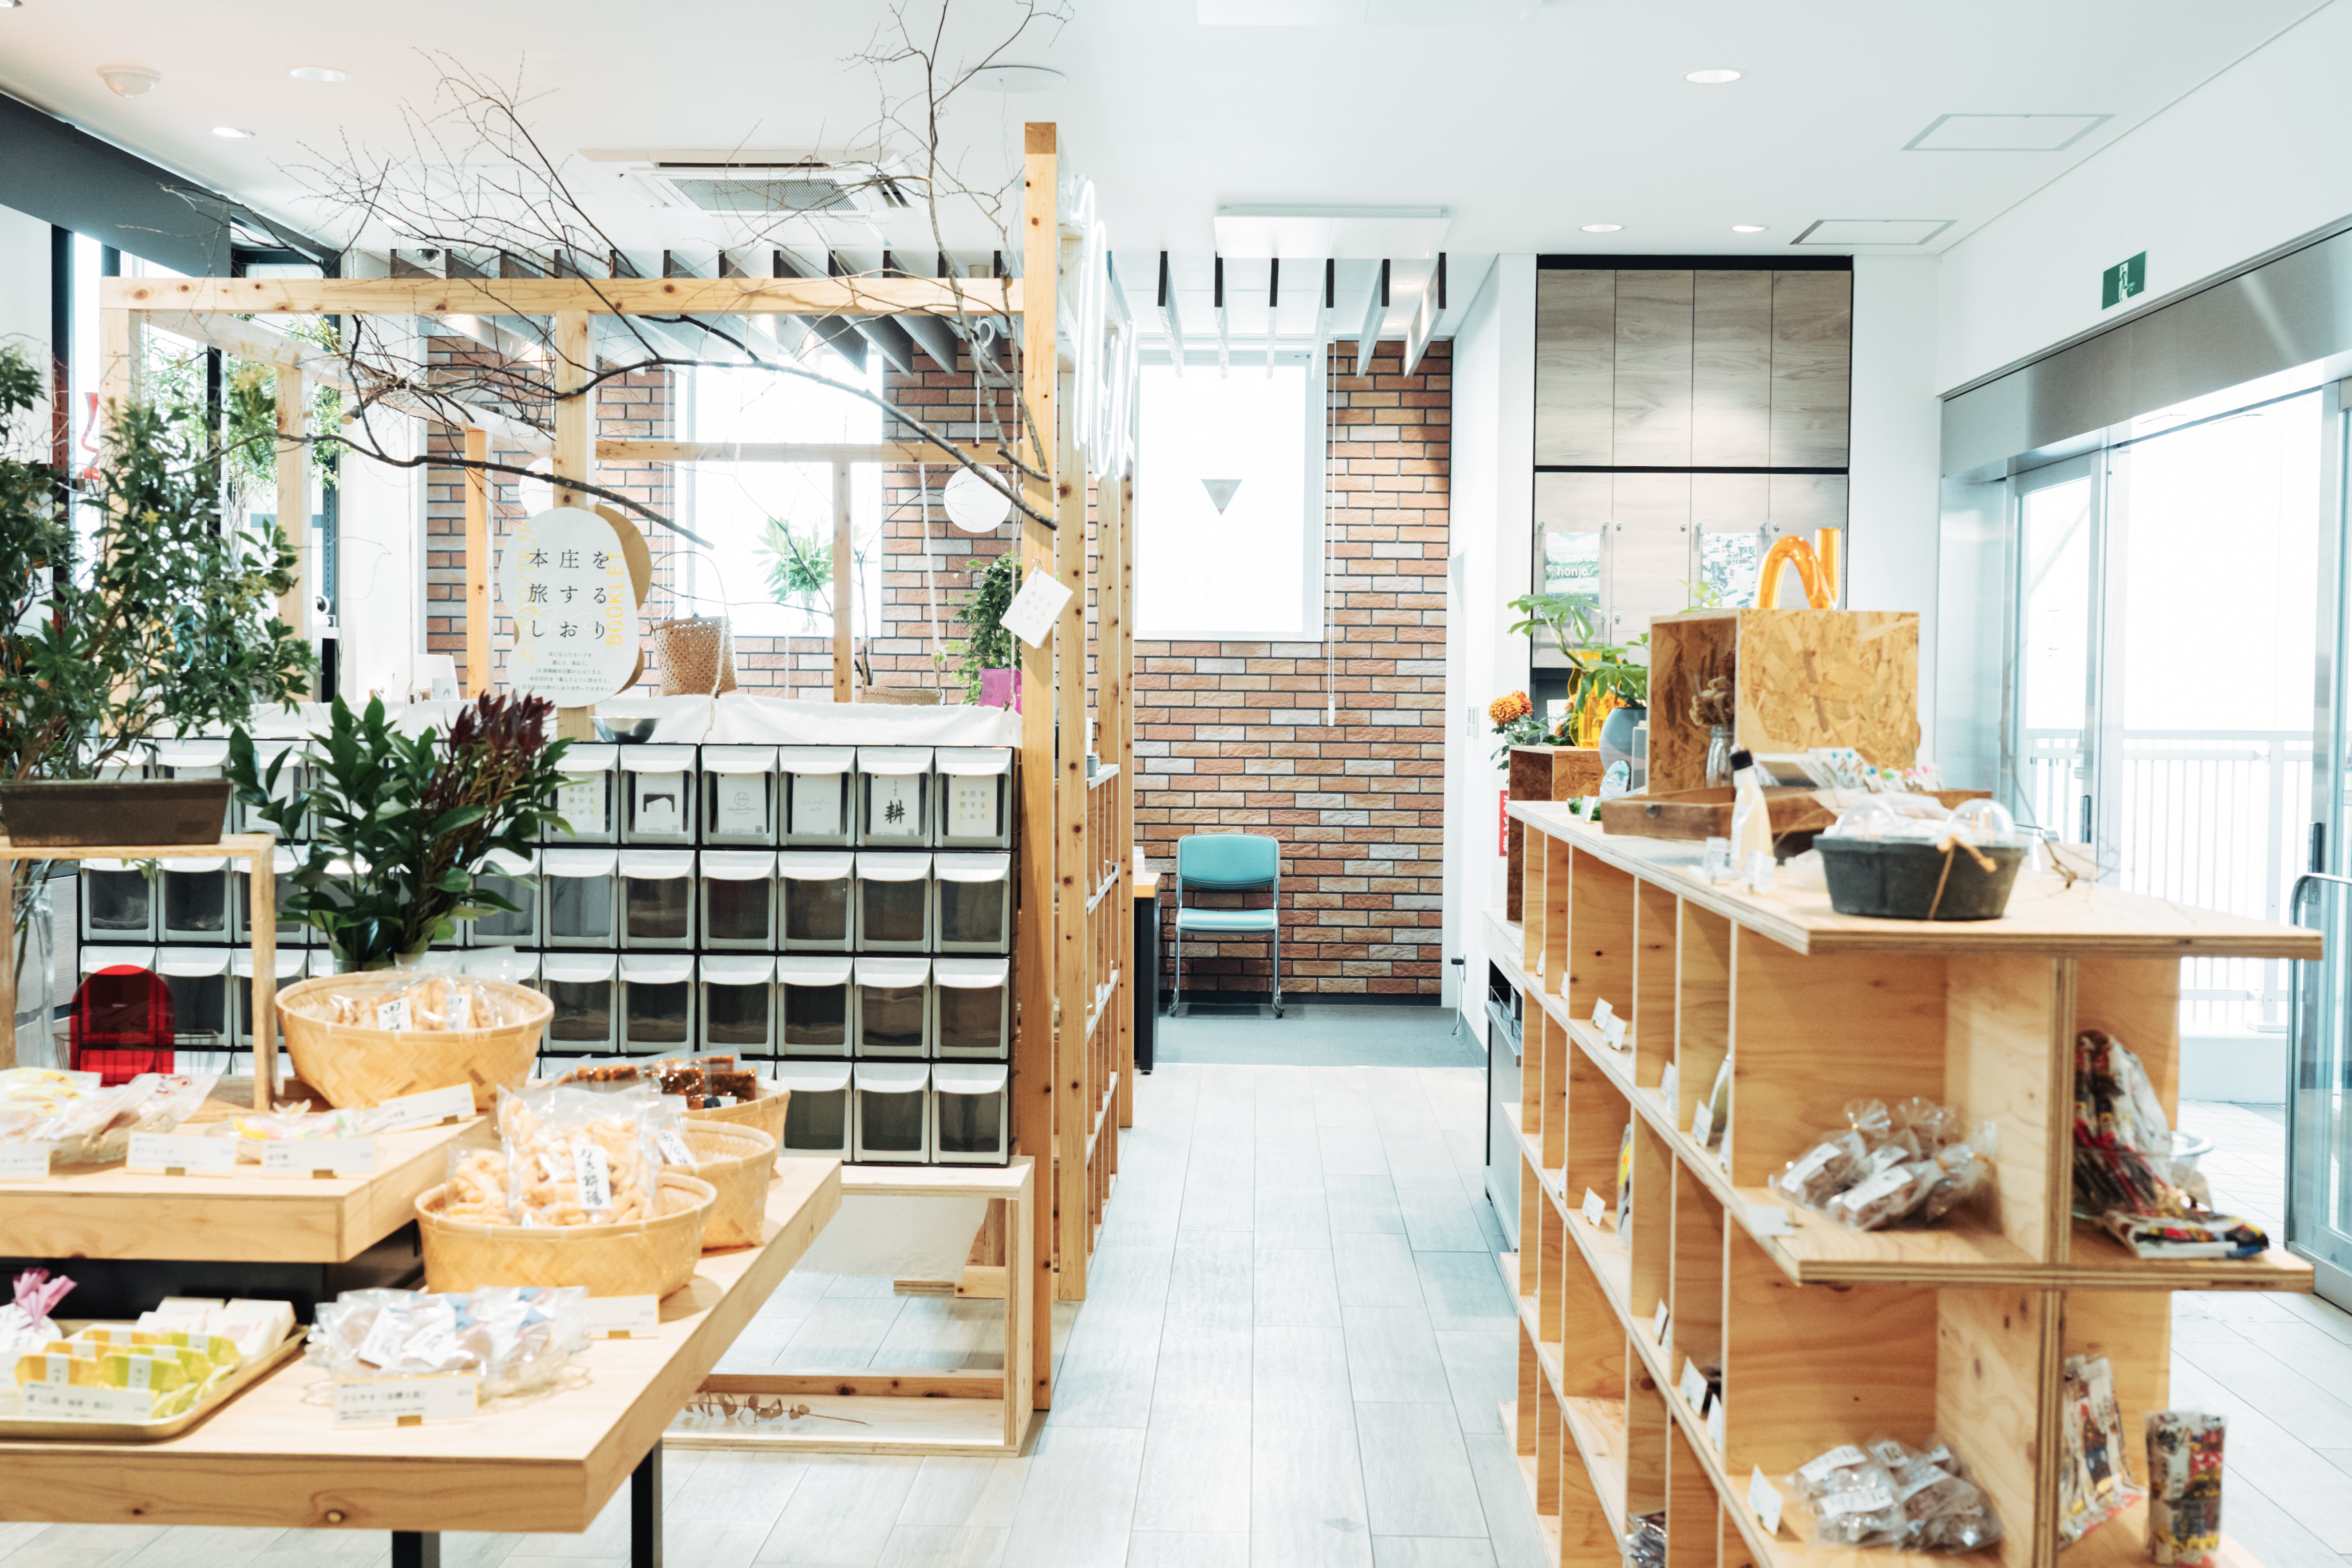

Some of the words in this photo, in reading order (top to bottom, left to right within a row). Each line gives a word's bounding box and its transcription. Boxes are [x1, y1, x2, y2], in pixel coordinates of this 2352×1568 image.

[529, 548, 609, 569] 本庄を
[1558, 566, 1588, 579] honjo
[528, 583, 607, 603] 旅する
[606, 550, 624, 645] BOOKLET
[532, 620, 604, 640] しおり
[884, 799, 905, 825] 耕
